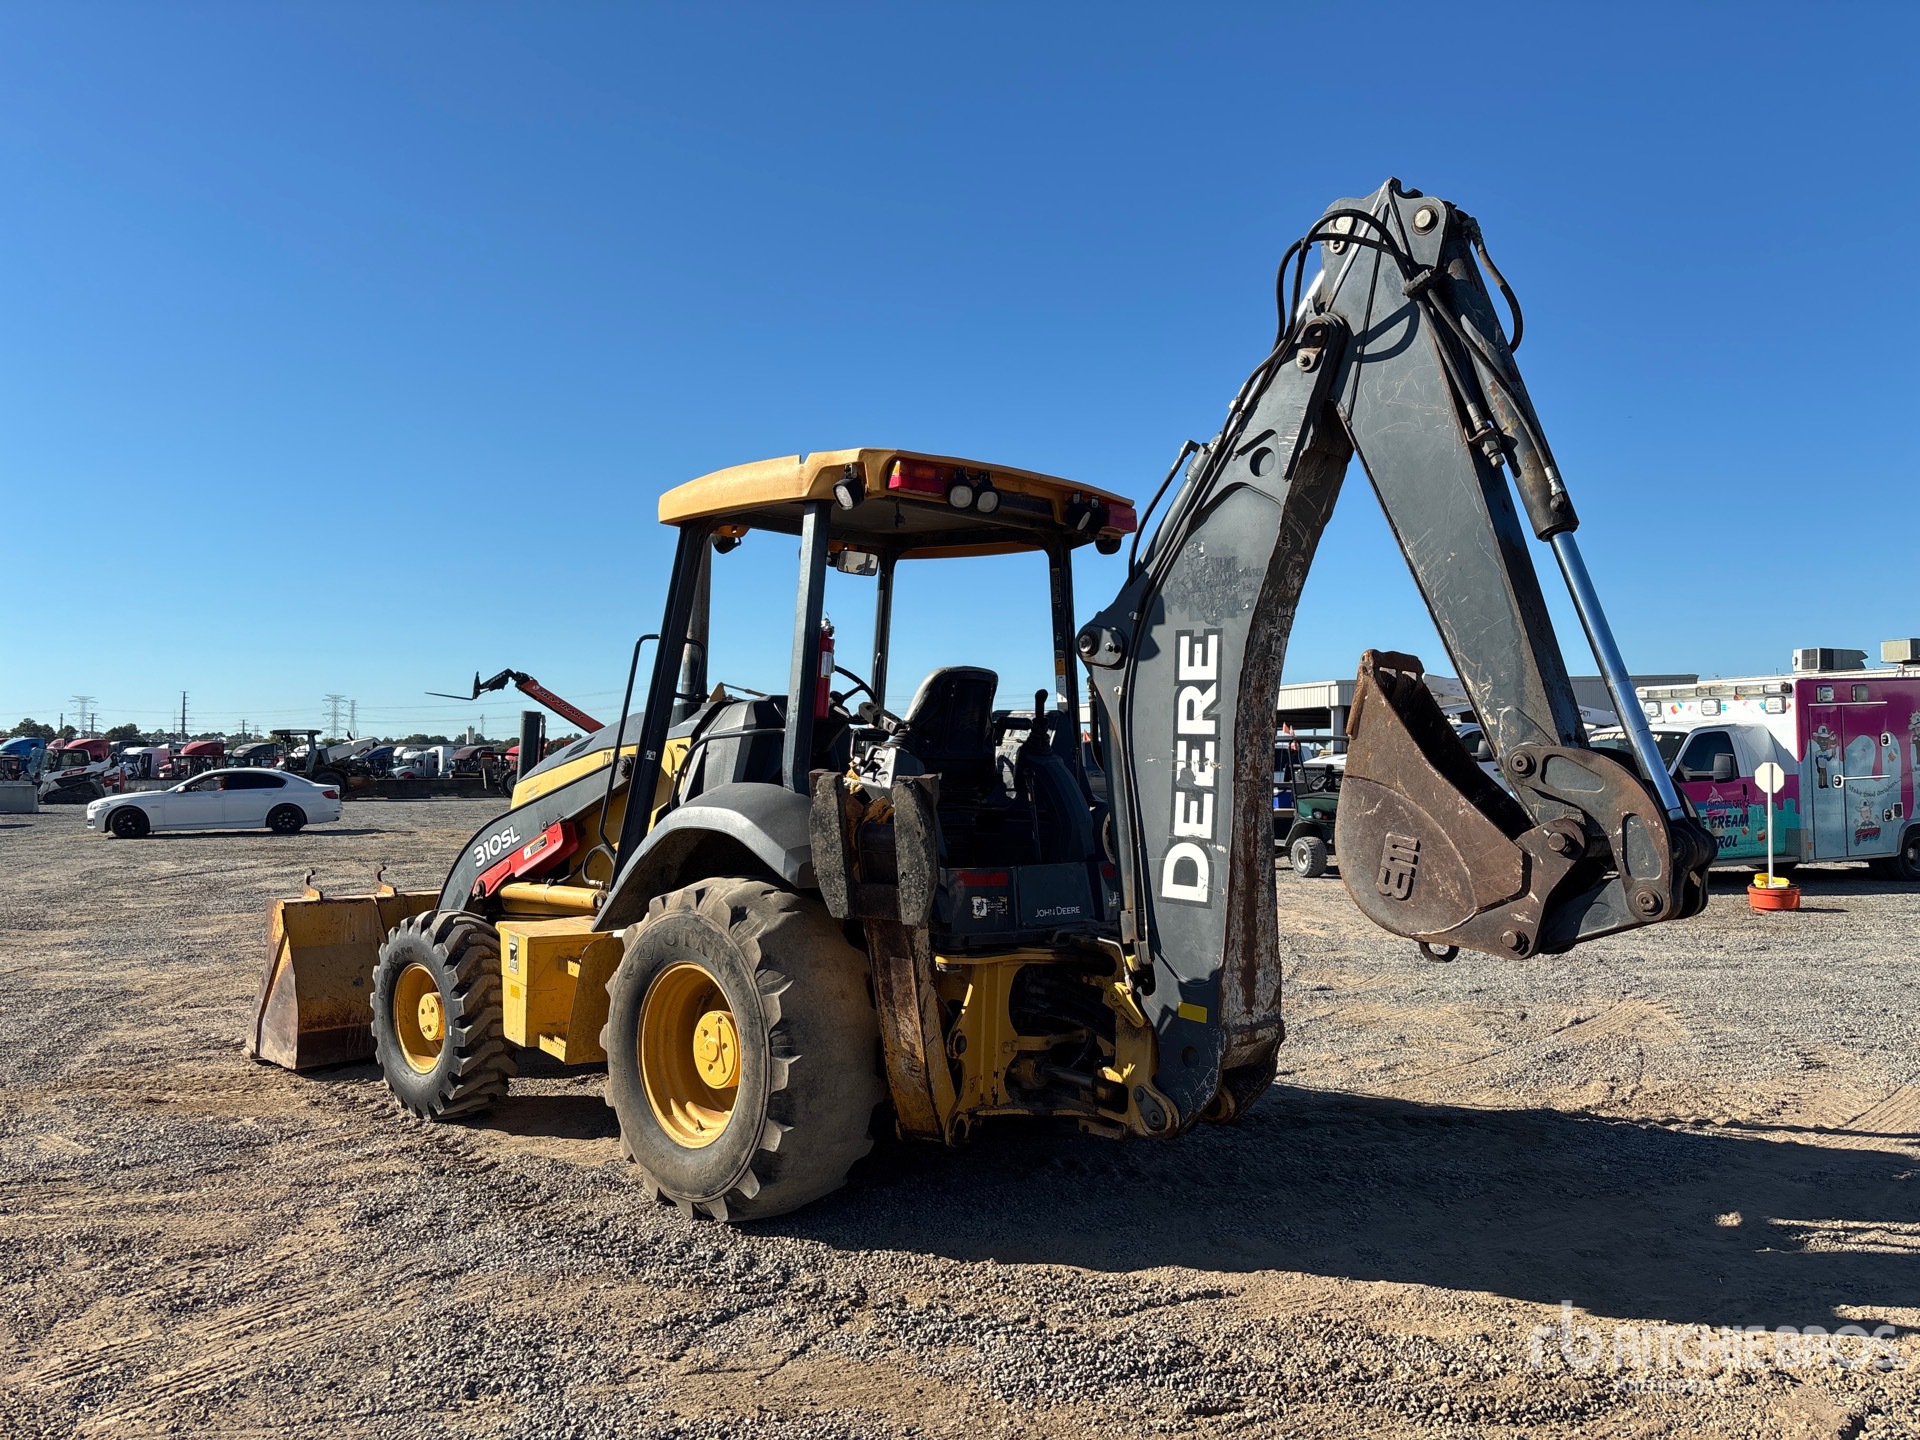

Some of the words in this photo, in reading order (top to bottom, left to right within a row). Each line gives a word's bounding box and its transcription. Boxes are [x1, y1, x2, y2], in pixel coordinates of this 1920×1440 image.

[1161, 635, 1218, 903] DEERE
[1711, 814, 1749, 829] CREAM
[473, 825, 521, 868] 310SL
[1035, 908, 1055, 918] JOHN
[1056, 906, 1081, 915] DEERE
